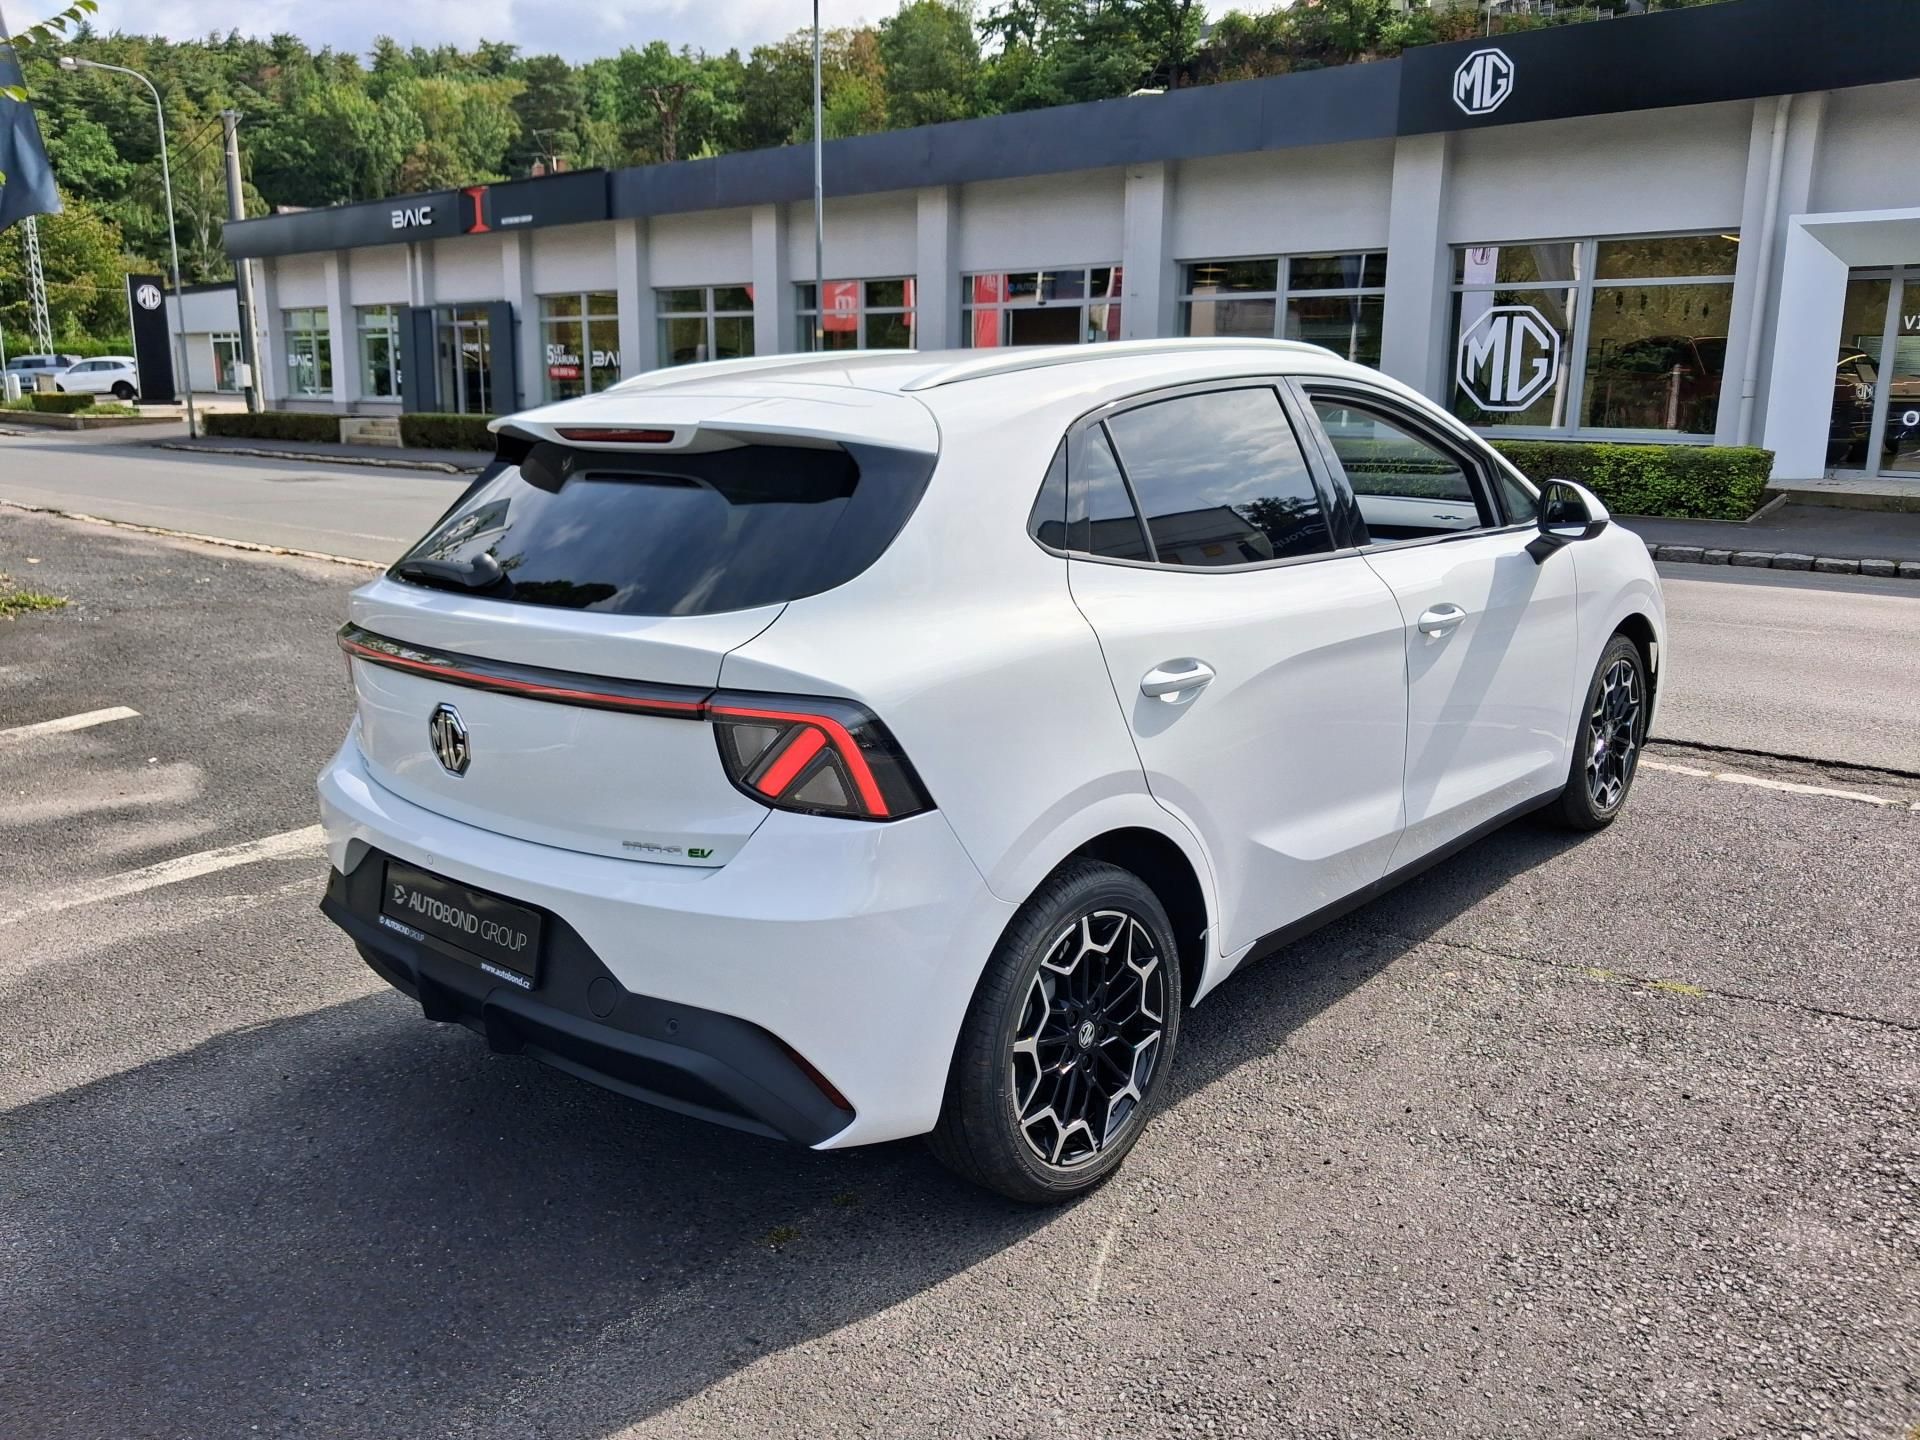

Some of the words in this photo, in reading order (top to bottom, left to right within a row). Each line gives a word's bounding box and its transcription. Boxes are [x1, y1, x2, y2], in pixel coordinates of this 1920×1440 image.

[1457, 52, 1510, 110] MG
[391, 206, 432, 229] BAIC
[138, 285, 161, 309] MG
[1465, 315, 1550, 402] MG
[430, 711, 466, 770] MG
[687, 847, 714, 858] EV
[384, 918, 410, 936] AUTOBOND
[409, 929, 425, 942] GROUP
[408, 891, 479, 934] AUTOBOND
[480, 919, 527, 952] GROUP
[480, 962, 530, 990] www.autobond.cz
